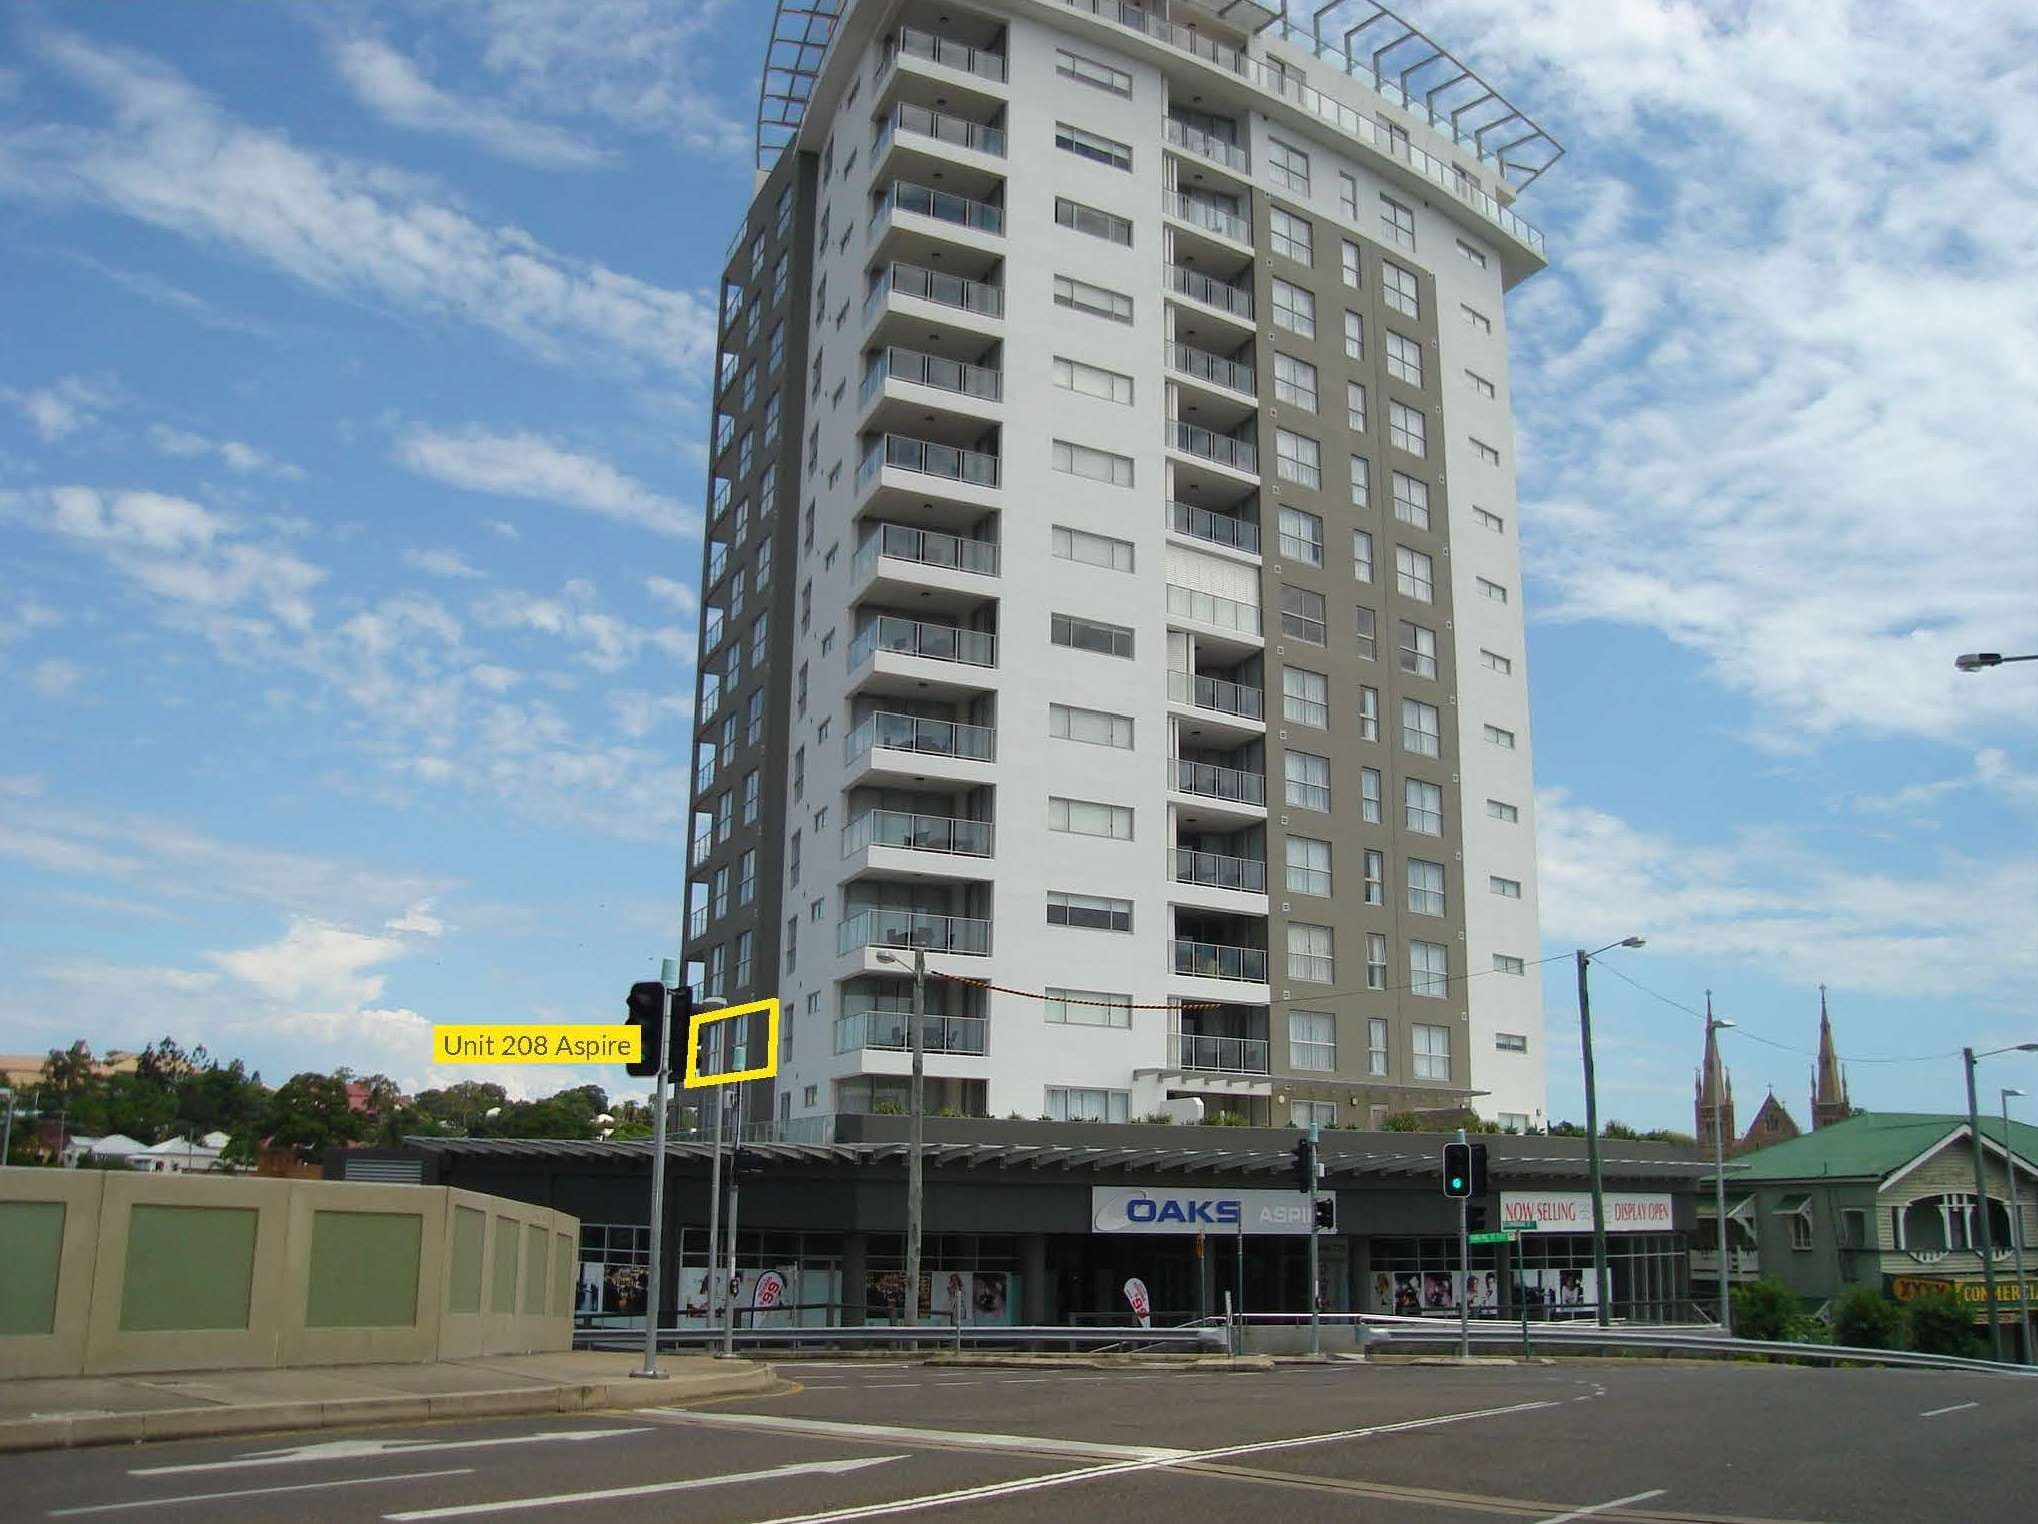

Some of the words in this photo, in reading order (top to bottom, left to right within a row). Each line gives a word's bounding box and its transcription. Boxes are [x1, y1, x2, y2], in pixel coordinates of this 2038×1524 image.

[1126, 1199, 1240, 1224] OAKS
[1258, 1206, 1313, 1223] ASPI
[1505, 1202, 1535, 1222] NOW
[1537, 1202, 1577, 1222] SELLING
[1614, 1202, 1648, 1222] DISPLAY
[1649, 1202, 1670, 1222] OPEN
[1964, 1284, 2038, 1302] COMERCI
